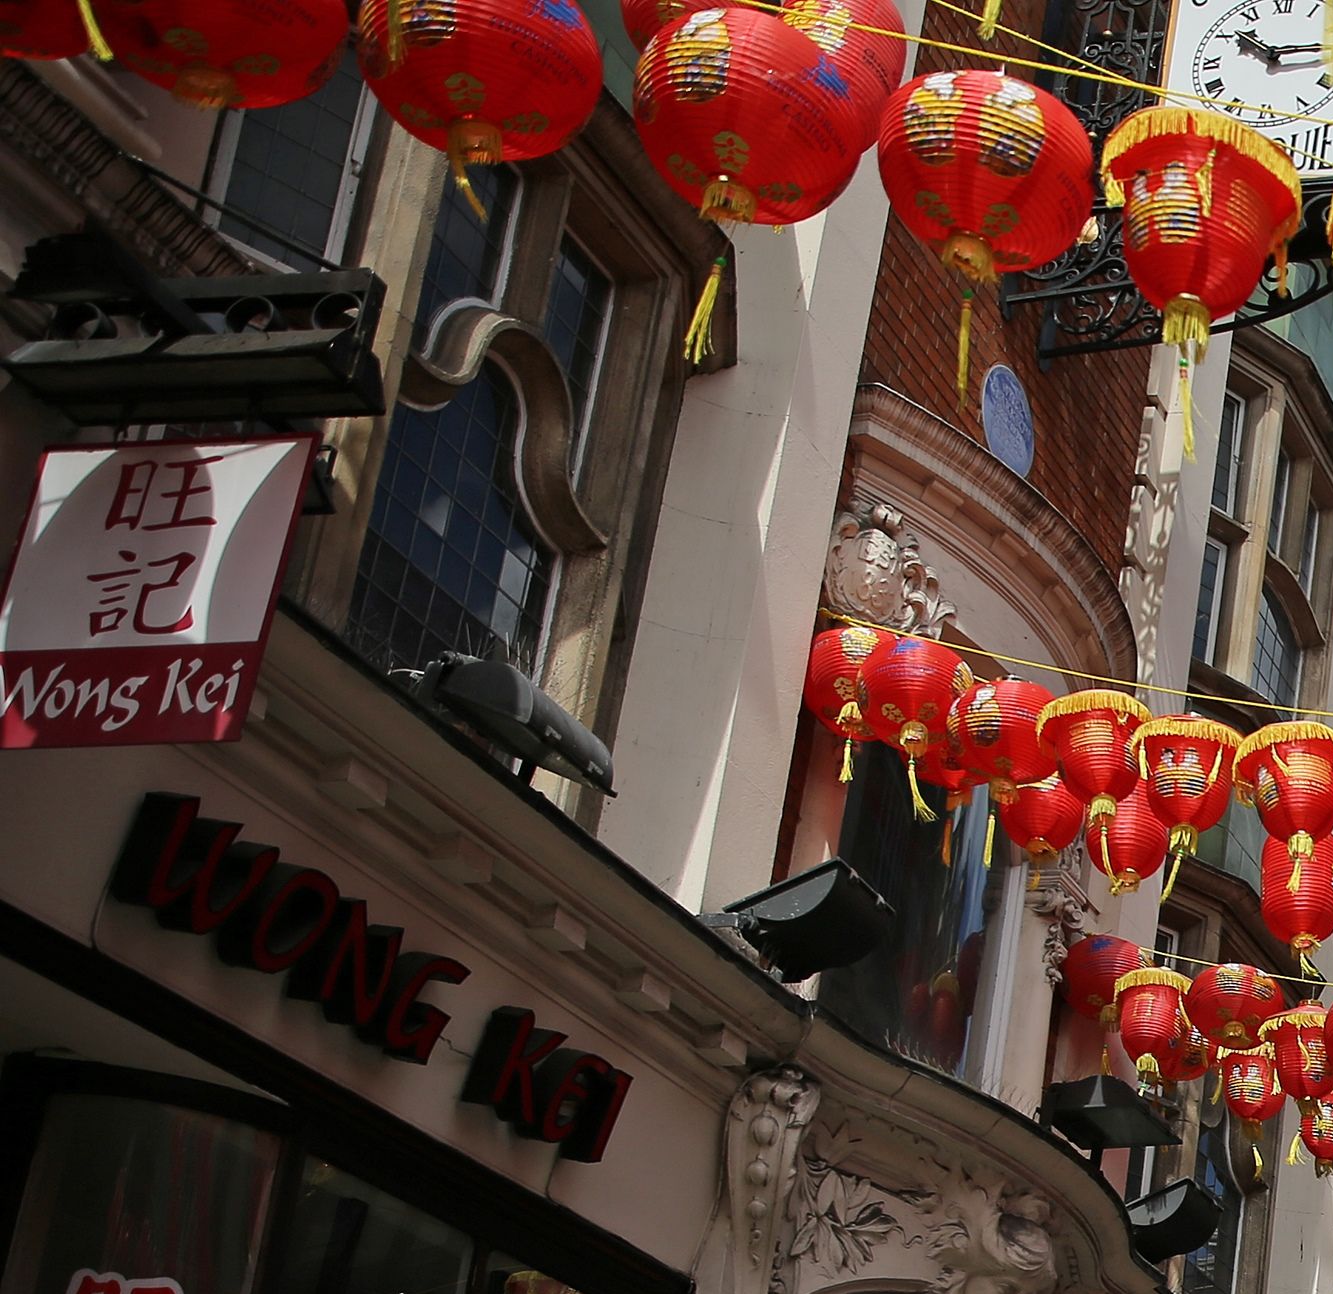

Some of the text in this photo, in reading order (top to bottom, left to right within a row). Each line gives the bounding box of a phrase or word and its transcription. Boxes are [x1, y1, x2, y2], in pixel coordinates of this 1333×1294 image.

[86, 455, 224, 638] 旺記
[0, 657, 246, 732] Wong Kei
[115, 792, 634, 1163] WONG KEI
